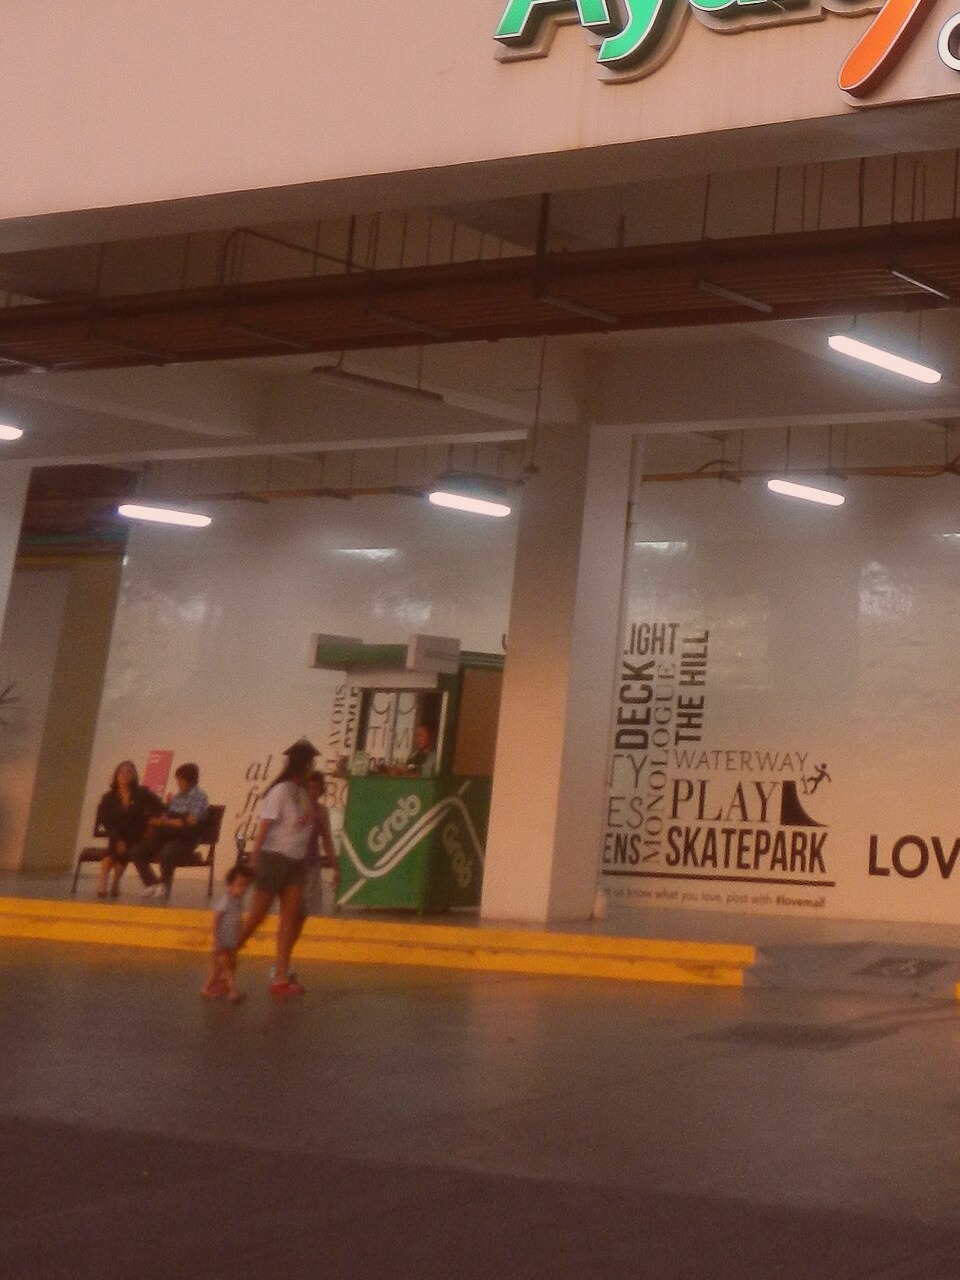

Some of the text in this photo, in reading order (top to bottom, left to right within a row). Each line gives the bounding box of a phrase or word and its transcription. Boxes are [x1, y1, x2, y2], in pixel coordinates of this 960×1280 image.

[614, 659, 656, 751] DECK
[674, 629, 710, 746] THE HILL
[641, 662, 676, 865] MONOLOGUE
[672, 748, 809, 772] WATERWAY
[367, 793, 422, 854] Grab
[667, 777, 781, 823] PLAY
[665, 825, 829, 874] SKATEPARK
